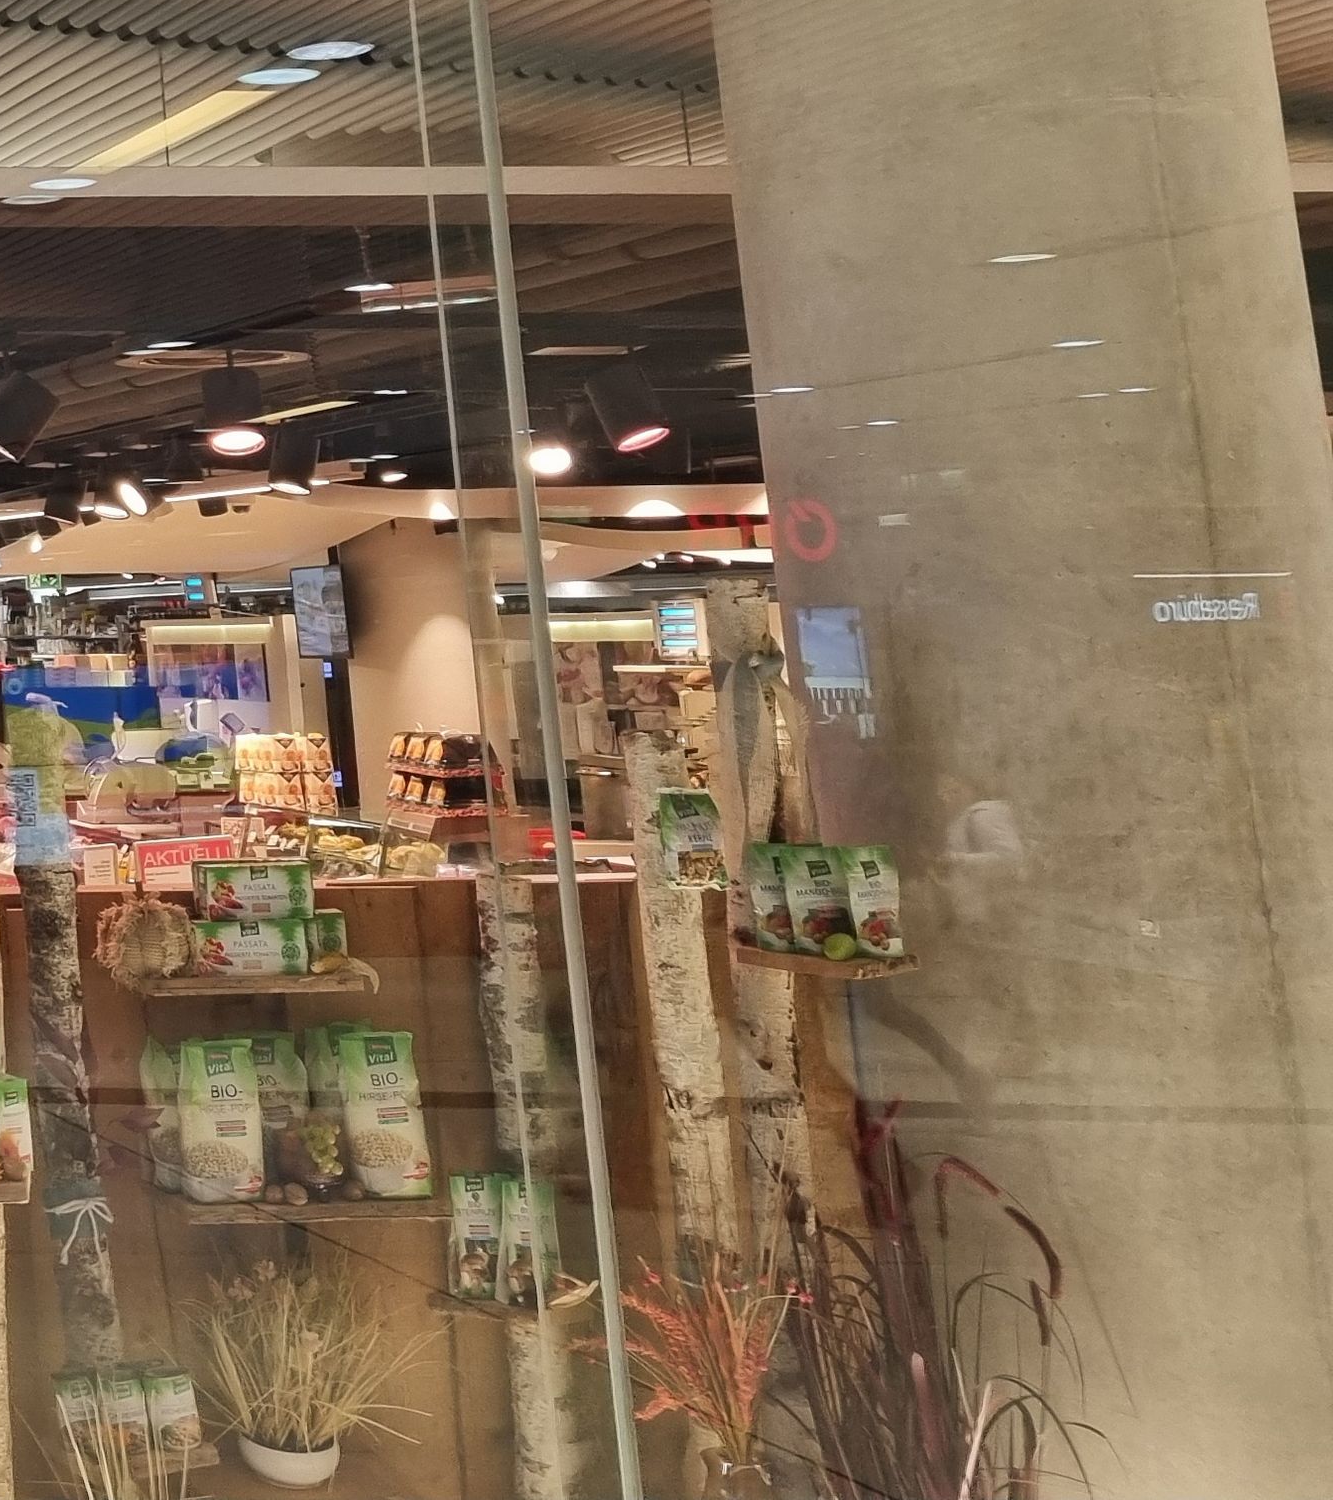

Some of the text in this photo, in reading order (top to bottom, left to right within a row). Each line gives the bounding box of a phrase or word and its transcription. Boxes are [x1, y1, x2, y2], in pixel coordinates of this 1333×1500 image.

[368, 1051, 395, 1064] Vital
[207, 1062, 234, 1075] Vital
[369, 1071, 405, 1088] BIO-
[211, 1083, 244, 1099] BIO-
